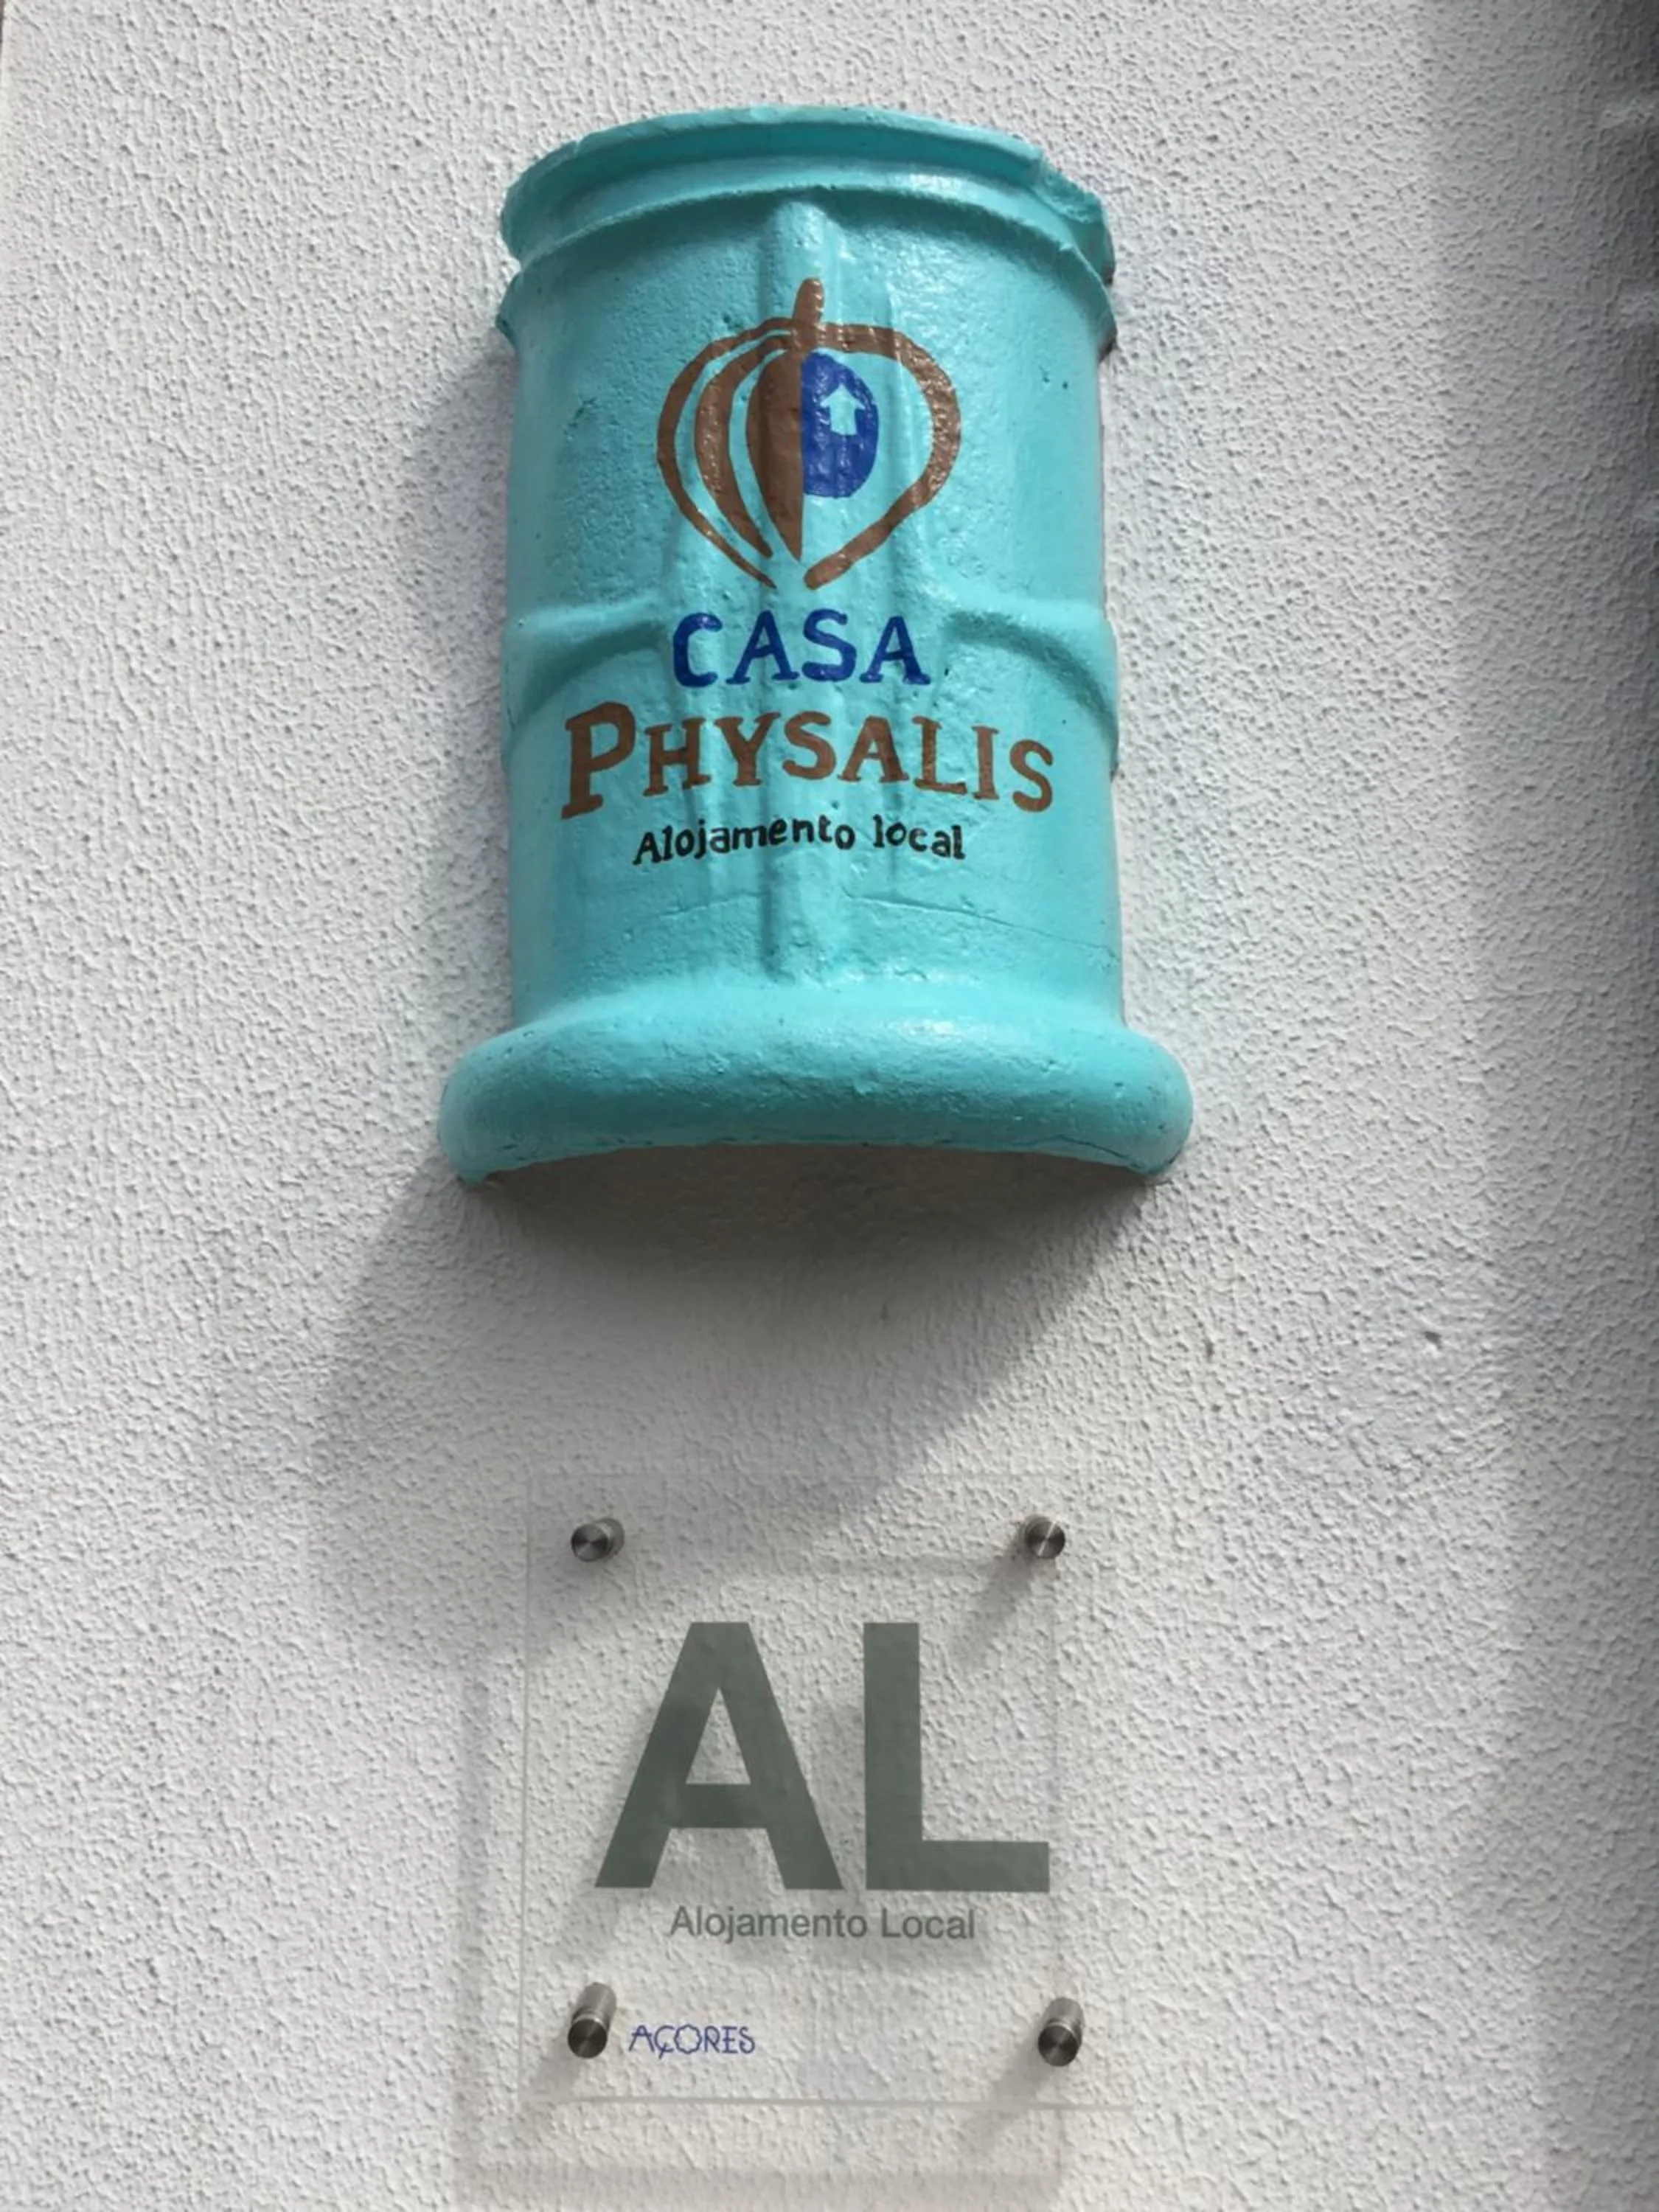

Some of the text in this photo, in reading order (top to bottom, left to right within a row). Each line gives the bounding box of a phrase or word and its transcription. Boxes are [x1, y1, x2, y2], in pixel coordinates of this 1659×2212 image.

[672, 608, 931, 688] CASA
[560, 701, 1054, 818] PHYSALIS
[633, 814, 965, 866] Alojamento local
[594, 1621, 1051, 1893] AL
[669, 1906, 975, 1944] Alojamento Local
[627, 2023, 756, 2059] AÇORES
